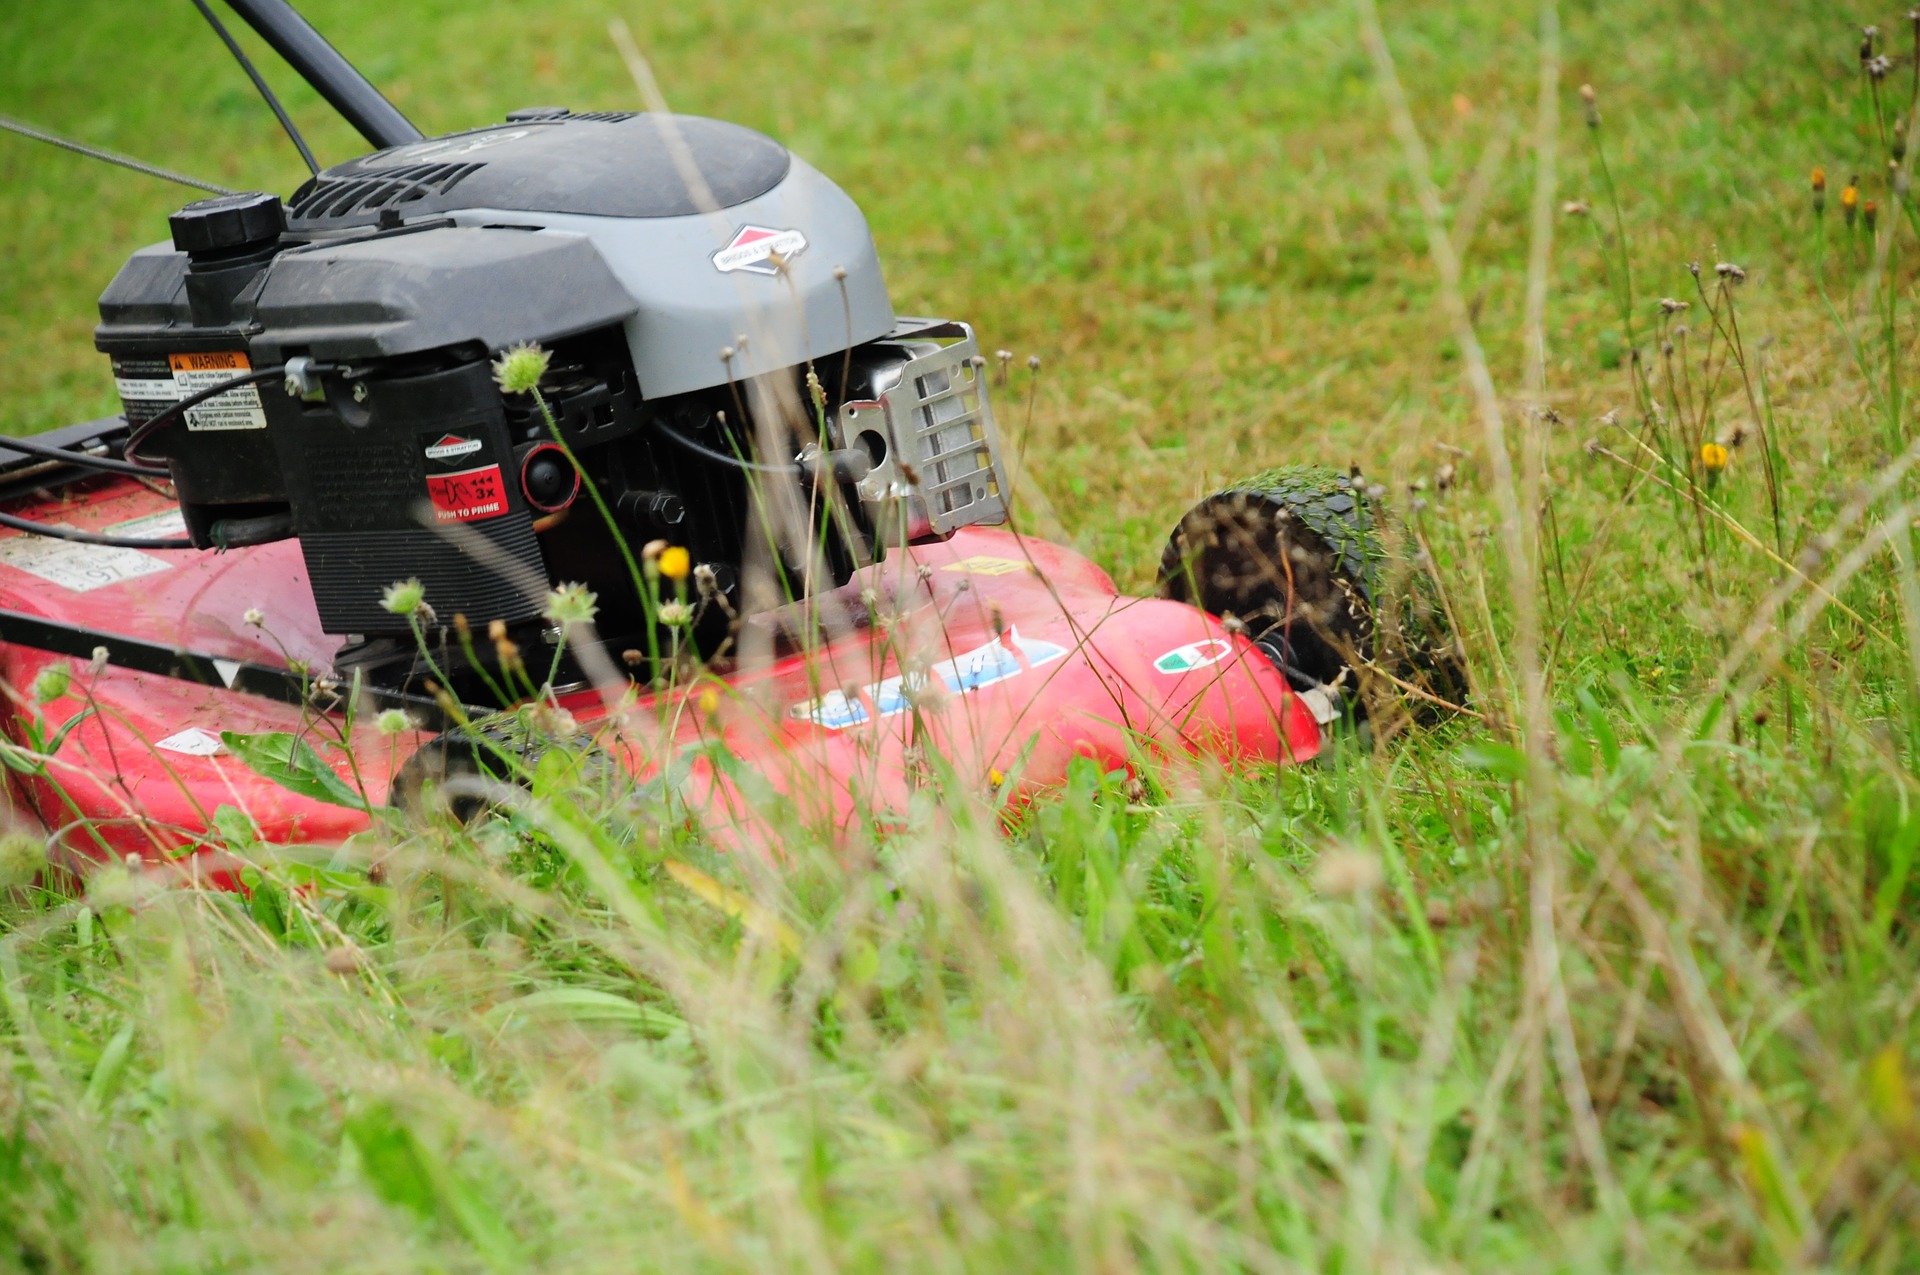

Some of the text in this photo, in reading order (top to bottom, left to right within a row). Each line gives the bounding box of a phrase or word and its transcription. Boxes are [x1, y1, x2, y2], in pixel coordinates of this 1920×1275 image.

[188, 353, 236, 369] WARNING
[438, 502, 499, 519] PUSH TO PRIME
